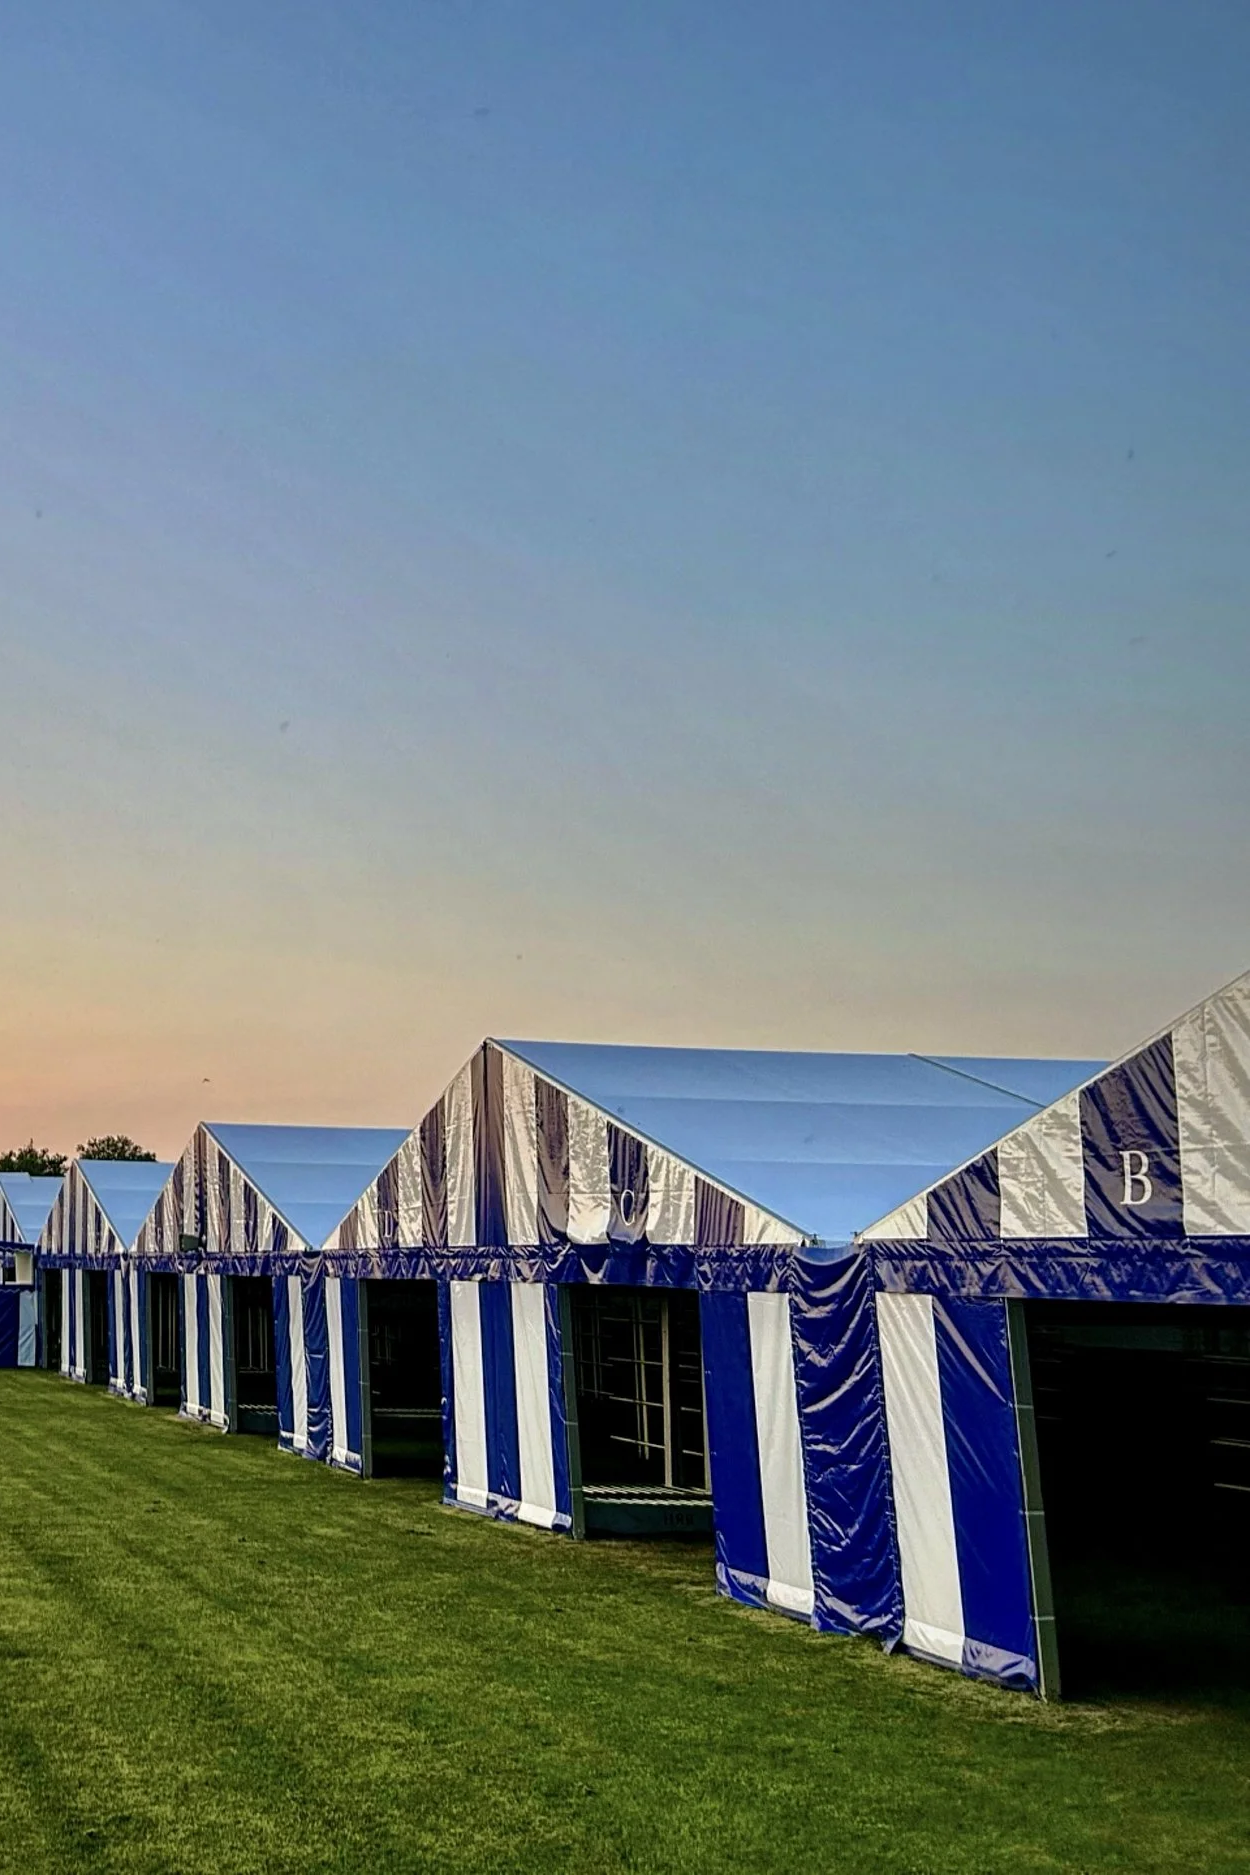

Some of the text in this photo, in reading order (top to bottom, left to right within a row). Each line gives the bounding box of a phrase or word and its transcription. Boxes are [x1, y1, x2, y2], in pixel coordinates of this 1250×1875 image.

[1118, 1150, 1153, 1205] B
[383, 1210, 394, 1238] D
[620, 1189, 635, 1226] C
